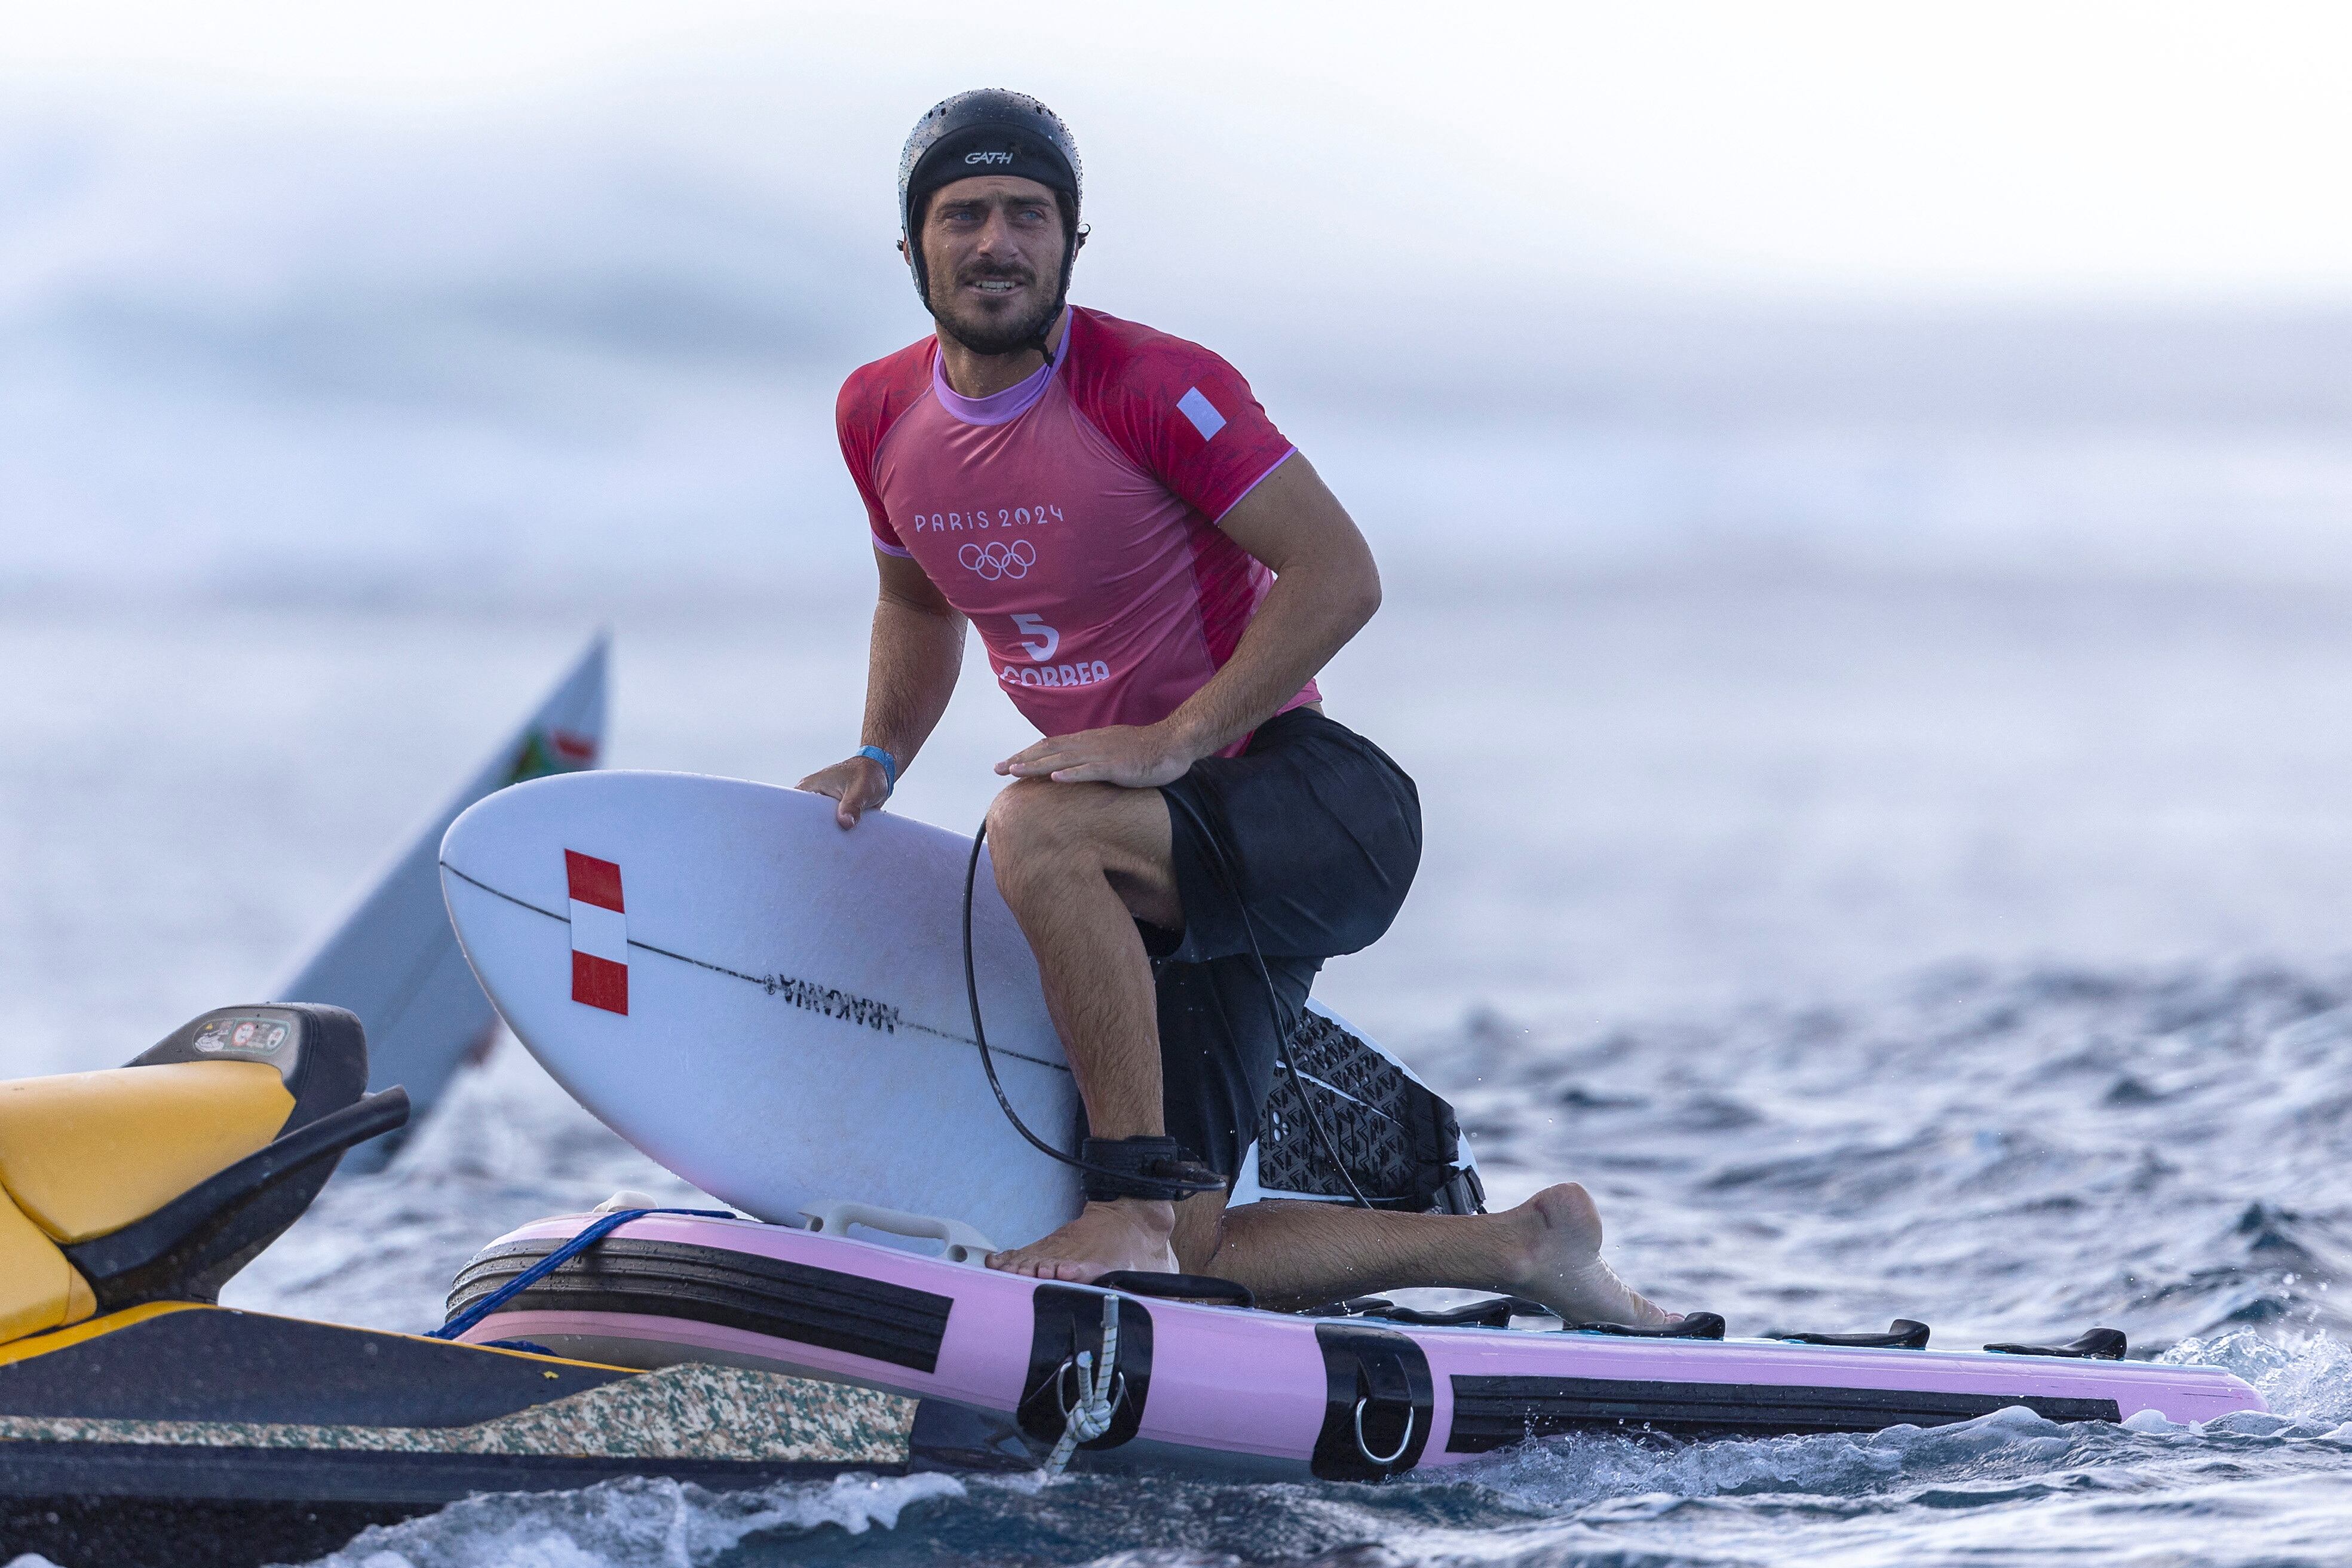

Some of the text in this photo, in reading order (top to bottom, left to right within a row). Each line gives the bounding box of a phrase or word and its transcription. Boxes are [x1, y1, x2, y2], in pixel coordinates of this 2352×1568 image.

[965, 151, 1014, 165] GATH
[999, 504, 1065, 527] 2024
[1010, 613, 1060, 662] 5
[999, 660, 1110, 686] CORREA
